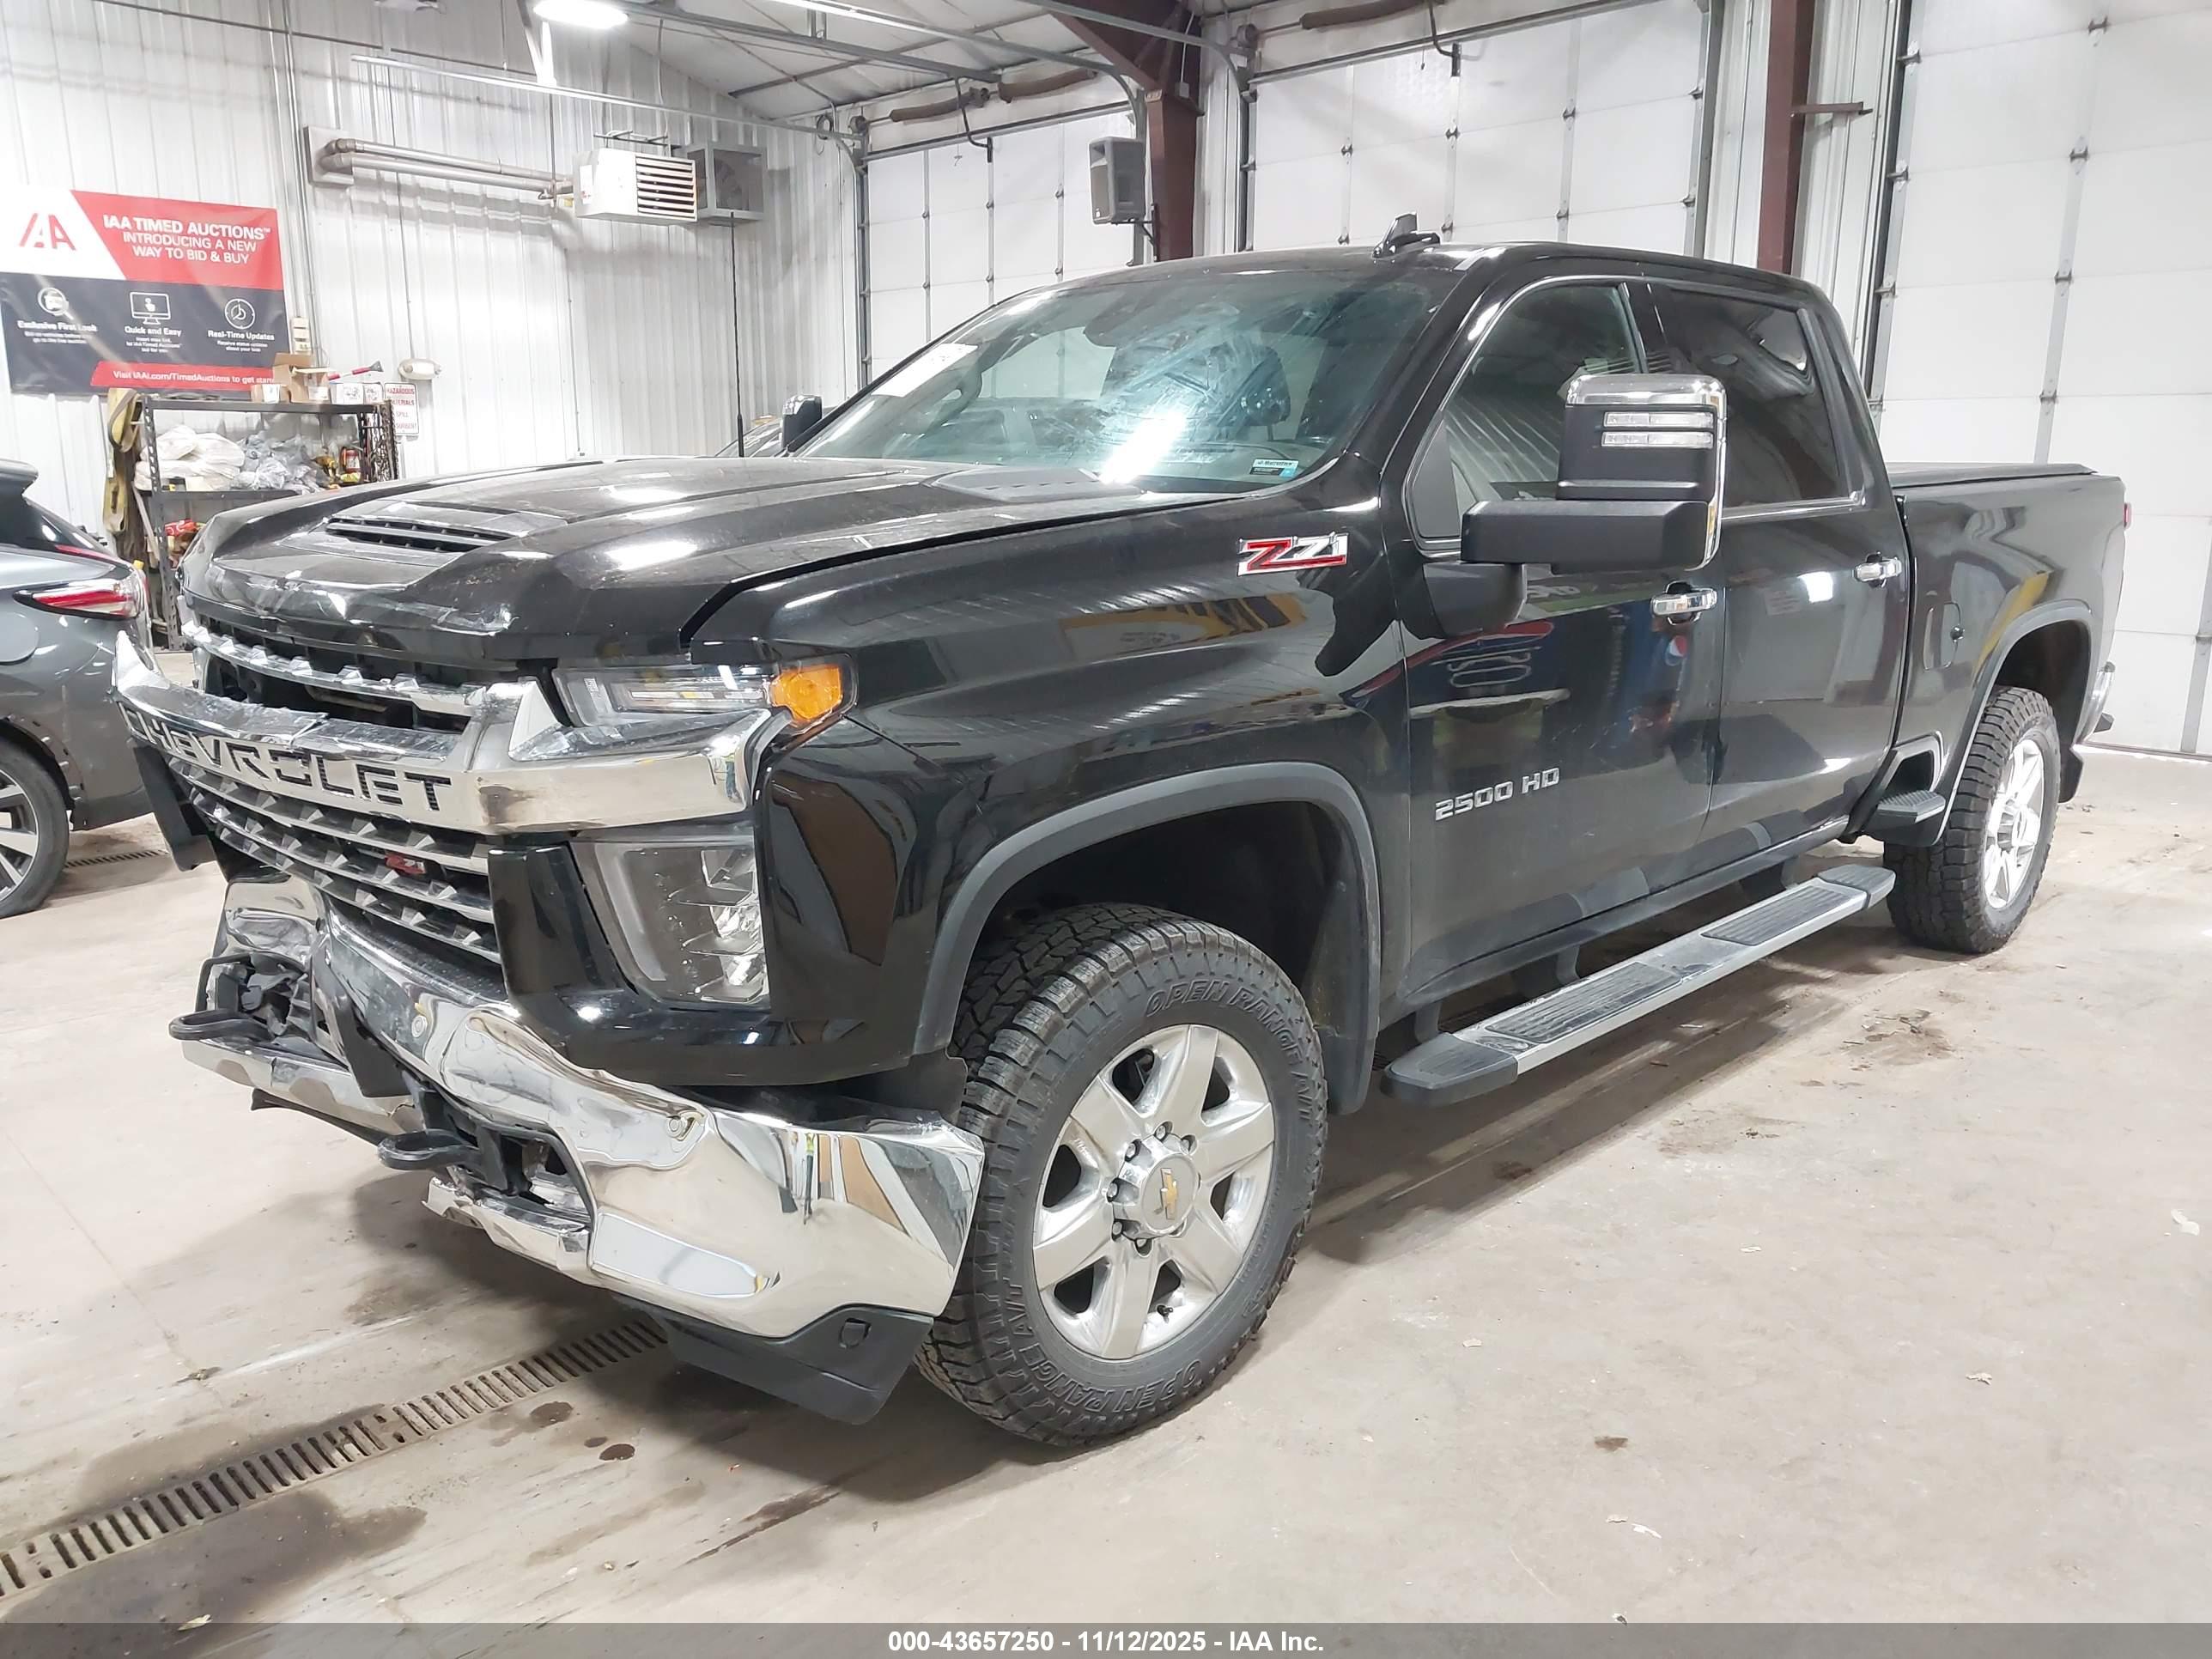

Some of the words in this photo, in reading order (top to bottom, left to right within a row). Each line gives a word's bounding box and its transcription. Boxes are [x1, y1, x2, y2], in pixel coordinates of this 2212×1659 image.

[103, 215, 131, 229] IAA
[132, 217, 182, 234] TIMED
[123, 231, 211, 249] INTRODUCING
[215, 239, 225, 250] A
[227, 240, 257, 252] NEW
[132, 246, 161, 258] WAY
[165, 247, 184, 259] TO
[187, 249, 207, 262] BID
[210, 251, 222, 263] &
[223, 252, 249, 264] BUY
[125, 325, 146, 335] Quick
[163, 328, 182, 337] Easy
[208, 330, 245, 338] Real-Time
[246, 331, 275, 340] Updates
[242, 376, 254, 385] get
[1237, 532, 1349, 576] Z71
[118, 701, 452, 811] CHEVROLET
[1435, 781, 1514, 821] 2500
[1522, 767, 1559, 794] HD
[1146, 979, 1230, 1018] OPEN
[1226, 987, 1304, 1066] RANGE
[1018, 1342, 1115, 1413] RANGE
[1112, 1359, 1202, 1413] OPEN
